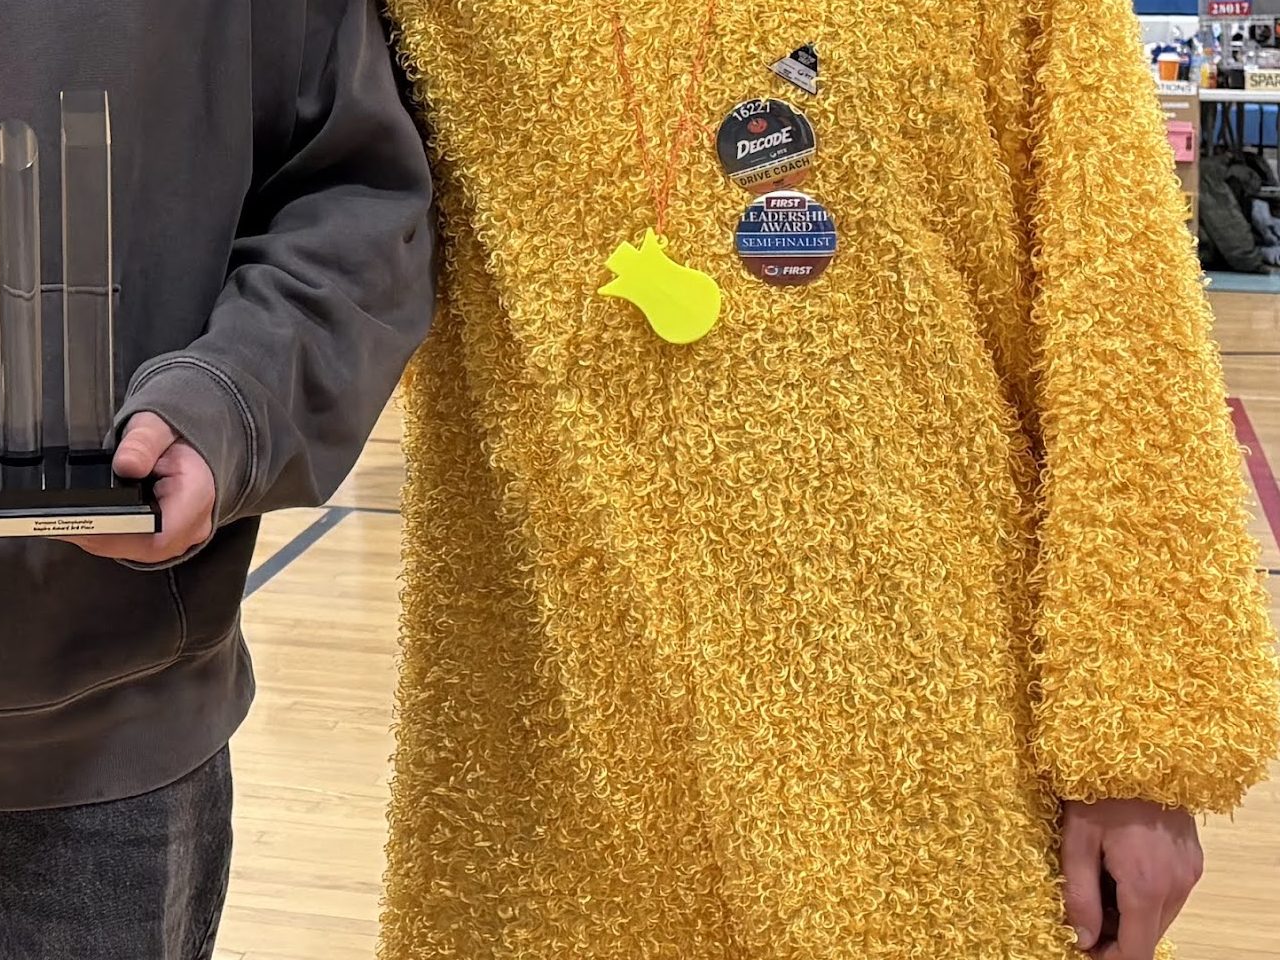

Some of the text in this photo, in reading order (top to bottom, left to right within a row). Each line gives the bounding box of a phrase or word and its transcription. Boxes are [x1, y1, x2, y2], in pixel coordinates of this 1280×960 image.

[732, 101, 771, 121] 16221
[736, 126, 793, 160] DECODE
[740, 170, 771, 187] DRIVE
[773, 157, 810, 175] COACH
[770, 199, 800, 208] FIRST
[760, 221, 813, 233] AWARD
[742, 237, 832, 248] SEMI-FINALIST
[782, 266, 813, 275] FIRST
